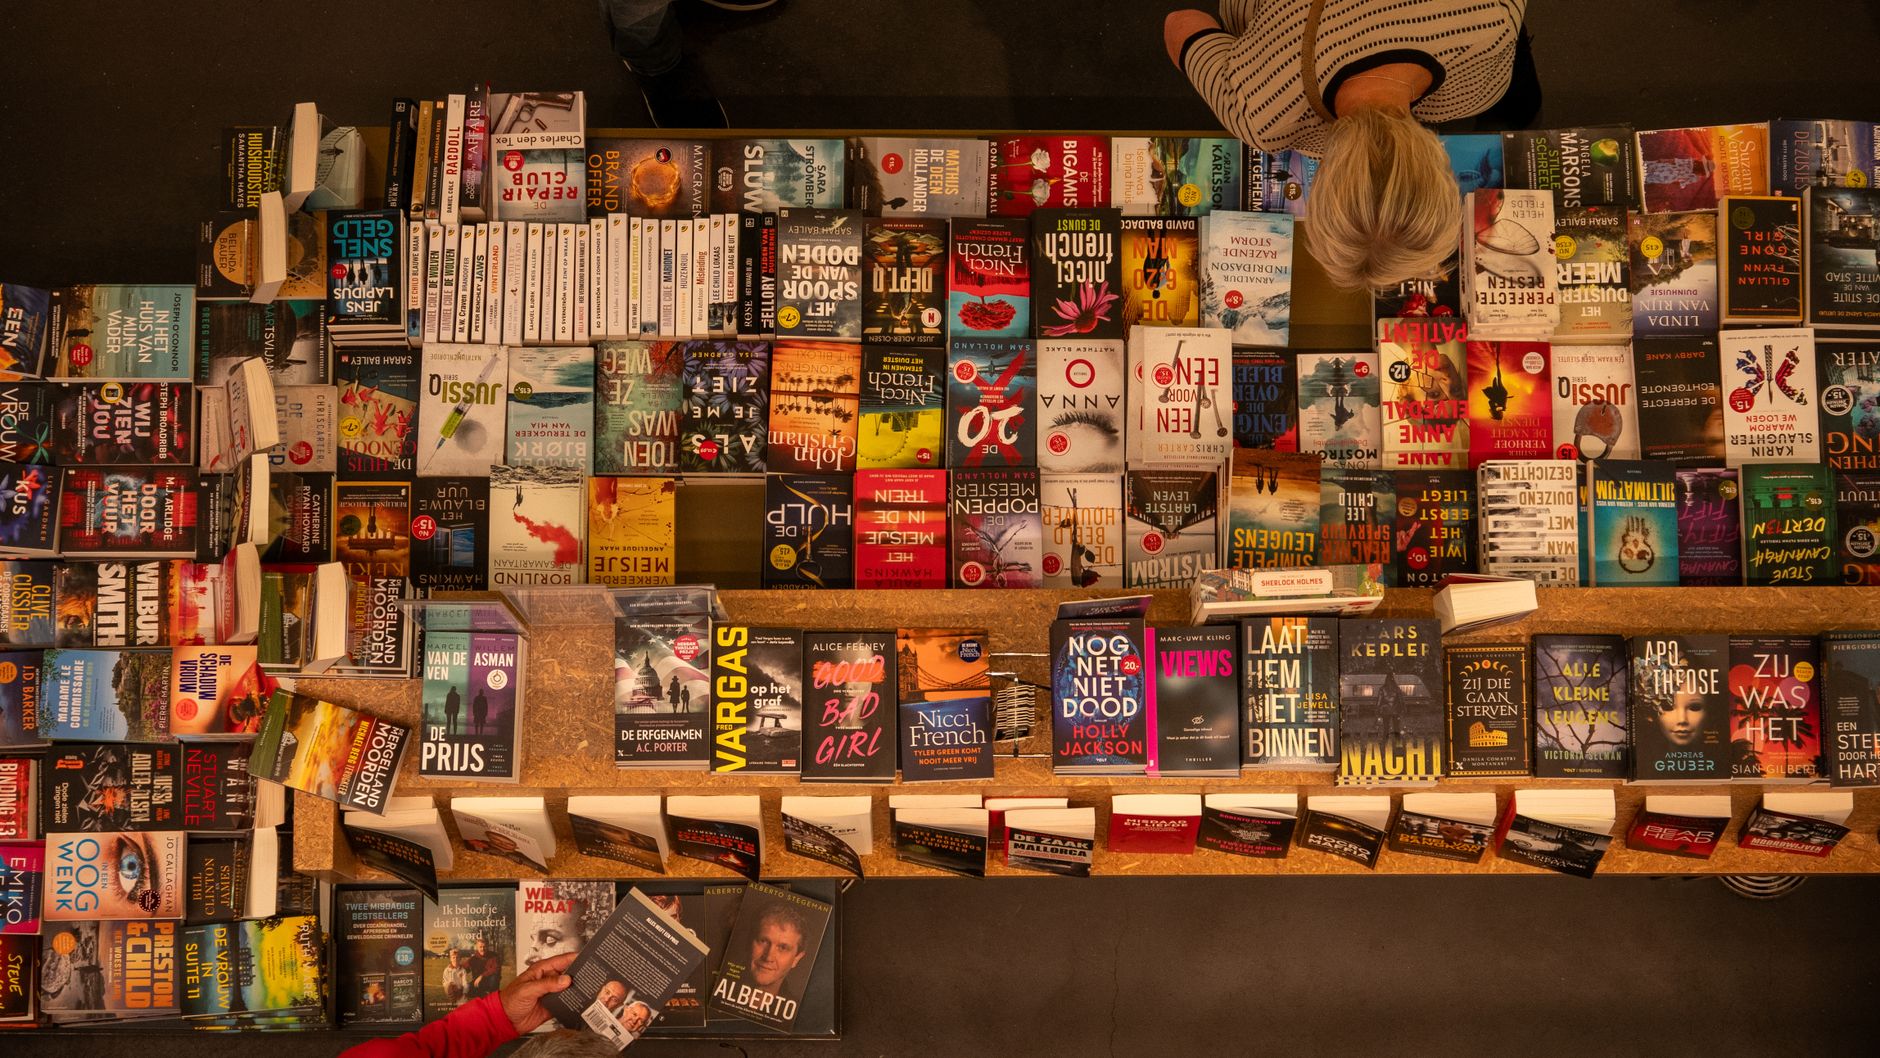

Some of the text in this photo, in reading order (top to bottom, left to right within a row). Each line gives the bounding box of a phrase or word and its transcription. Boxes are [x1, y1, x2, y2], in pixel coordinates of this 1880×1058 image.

[496, 137, 513, 145] Tex
[540, 136, 581, 144] Charles
[447, 126, 460, 175] RAGDOLL
[1580, 139, 1591, 177] ANGELA
[929, 149, 942, 195] DE DEEN
[945, 149, 959, 195] MATHIS
[1560, 133, 1580, 208] MARSONS
[513, 172, 566, 185] CLUB
[913, 149, 928, 212] HOLLANDER
[503, 187, 577, 201] REPAIR
[333, 220, 393, 237] GELD
[1057, 220, 1100, 230] DE GUNST
[1231, 237, 1272, 246] STORM
[1744, 231, 1784, 241] GIRL
[334, 239, 393, 257] SNEL
[1045, 233, 1113, 265] french
[1223, 249, 1277, 259] RAZENDE
[1740, 245, 1787, 254] GONE
[713, 246, 721, 269] LOKAAS
[476, 255, 484, 282] JAWS
[1057, 261, 1106, 288] nicci
[1212, 262, 1287, 274] INDRIDASON
[1744, 264, 1784, 272] FLYNN
[1224, 275, 1274, 284] ARNALDUR
[1738, 277, 1790, 285] GILLIAN
[334, 288, 393, 299] LAPIDUS
[346, 301, 381, 313] JENS
[107, 310, 122, 353] VADER
[123, 317, 136, 347] MIJN
[138, 301, 153, 363] HUIS VAN
[155, 311, 169, 353] IN HET
[172, 293, 181, 371] JOSEPH O'CONNOR
[1040, 395, 1120, 409] ANNA
[93, 400, 110, 438] JOU
[115, 397, 132, 444] ZIEN
[135, 402, 150, 437] WIJ
[1746, 415, 1777, 423] LOGEN
[159, 411, 167, 459] BROADRIBB
[1730, 433, 1813, 446] SLAUGHTER
[1752, 446, 1794, 457] KARIN
[875, 489, 928, 502] TREIN
[1596, 480, 1675, 501] ULTIMATUM
[875, 511, 924, 524] IN DE
[865, 531, 933, 544] MEISJE
[886, 552, 913, 562] HET
[1261, 577, 1323, 587] SHERLOCK HOLMES
[97, 564, 126, 646] SMITH
[136, 561, 159, 645] WILBUR
[370, 579, 387, 663] MOORDEN
[384, 579, 399, 663] MERGELLAND
[1160, 634, 1203, 642] MARC-UWE
[1248, 626, 1306, 654] LAAT
[813, 643, 843, 651] ALICE
[1070, 636, 1129, 656] NOG
[428, 652, 467, 666] VAN DE
[474, 653, 513, 666] ASMAN
[1077, 657, 1122, 675] NET
[1161, 650, 1232, 677] VIEWS
[1753, 654, 1789, 677] ZIJ
[428, 667, 448, 680] VEN
[1248, 660, 1300, 688] HEM
[1563, 663, 1601, 677] ALLE
[1073, 677, 1126, 697] NIET
[1463, 678, 1511, 690] ZIJ DIE
[1654, 669, 1719, 694] THEOSE
[751, 683, 791, 695] op het
[1553, 687, 1609, 701] KLEINE
[716, 627, 748, 772] VARGAS
[754, 695, 782, 708] graf
[1466, 692, 1514, 705] GAAN
[1739, 686, 1807, 709] WAS
[820, 693, 879, 726] BAD
[1064, 698, 1137, 718] DOOD
[1249, 694, 1298, 722] NIET
[1457, 705, 1518, 719] STERVEN
[918, 709, 971, 727] Nicci
[1544, 711, 1619, 725] LEUGENS
[431, 727, 446, 741] DE
[622, 729, 702, 740] DE ERFGENAMEN
[909, 725, 986, 747] French
[1073, 725, 1129, 739] HOLLY
[1746, 718, 1803, 741] HET
[636, 742, 687, 752] A.C. PORTER
[815, 728, 882, 763] GIRL
[1060, 742, 1142, 756] JACKSON
[1250, 729, 1334, 757] BINNEN
[422, 743, 484, 772] PRIJS
[1544, 750, 1622, 761] VICTORIA SELMAN
[1655, 760, 1714, 771] GRUBER
[1732, 765, 1816, 774] SIAN GILBERT
[1643, 832, 1712, 843] HEAD
[1646, 825, 1713, 837] BEAR
[1013, 833, 1089, 849] DE ZAAK
[1014, 843, 1087, 857] MALLORCA
[56, 841, 74, 911] WENK
[75, 839, 100, 912] OOG
[165, 837, 173, 913] JO CALLAGHAN
[525, 888, 554, 900] WIE
[749, 883, 829, 912] ALBERTO STEGEMAN
[370, 902, 415, 910] MISDADIGE
[443, 905, 497, 916] Ik beloof je
[524, 901, 574, 913] PRAAT
[352, 912, 408, 920] BESTSELLERS
[434, 917, 506, 927] dat ik honderd
[457, 931, 483, 940] word
[713, 979, 797, 1020] ALBERTO
